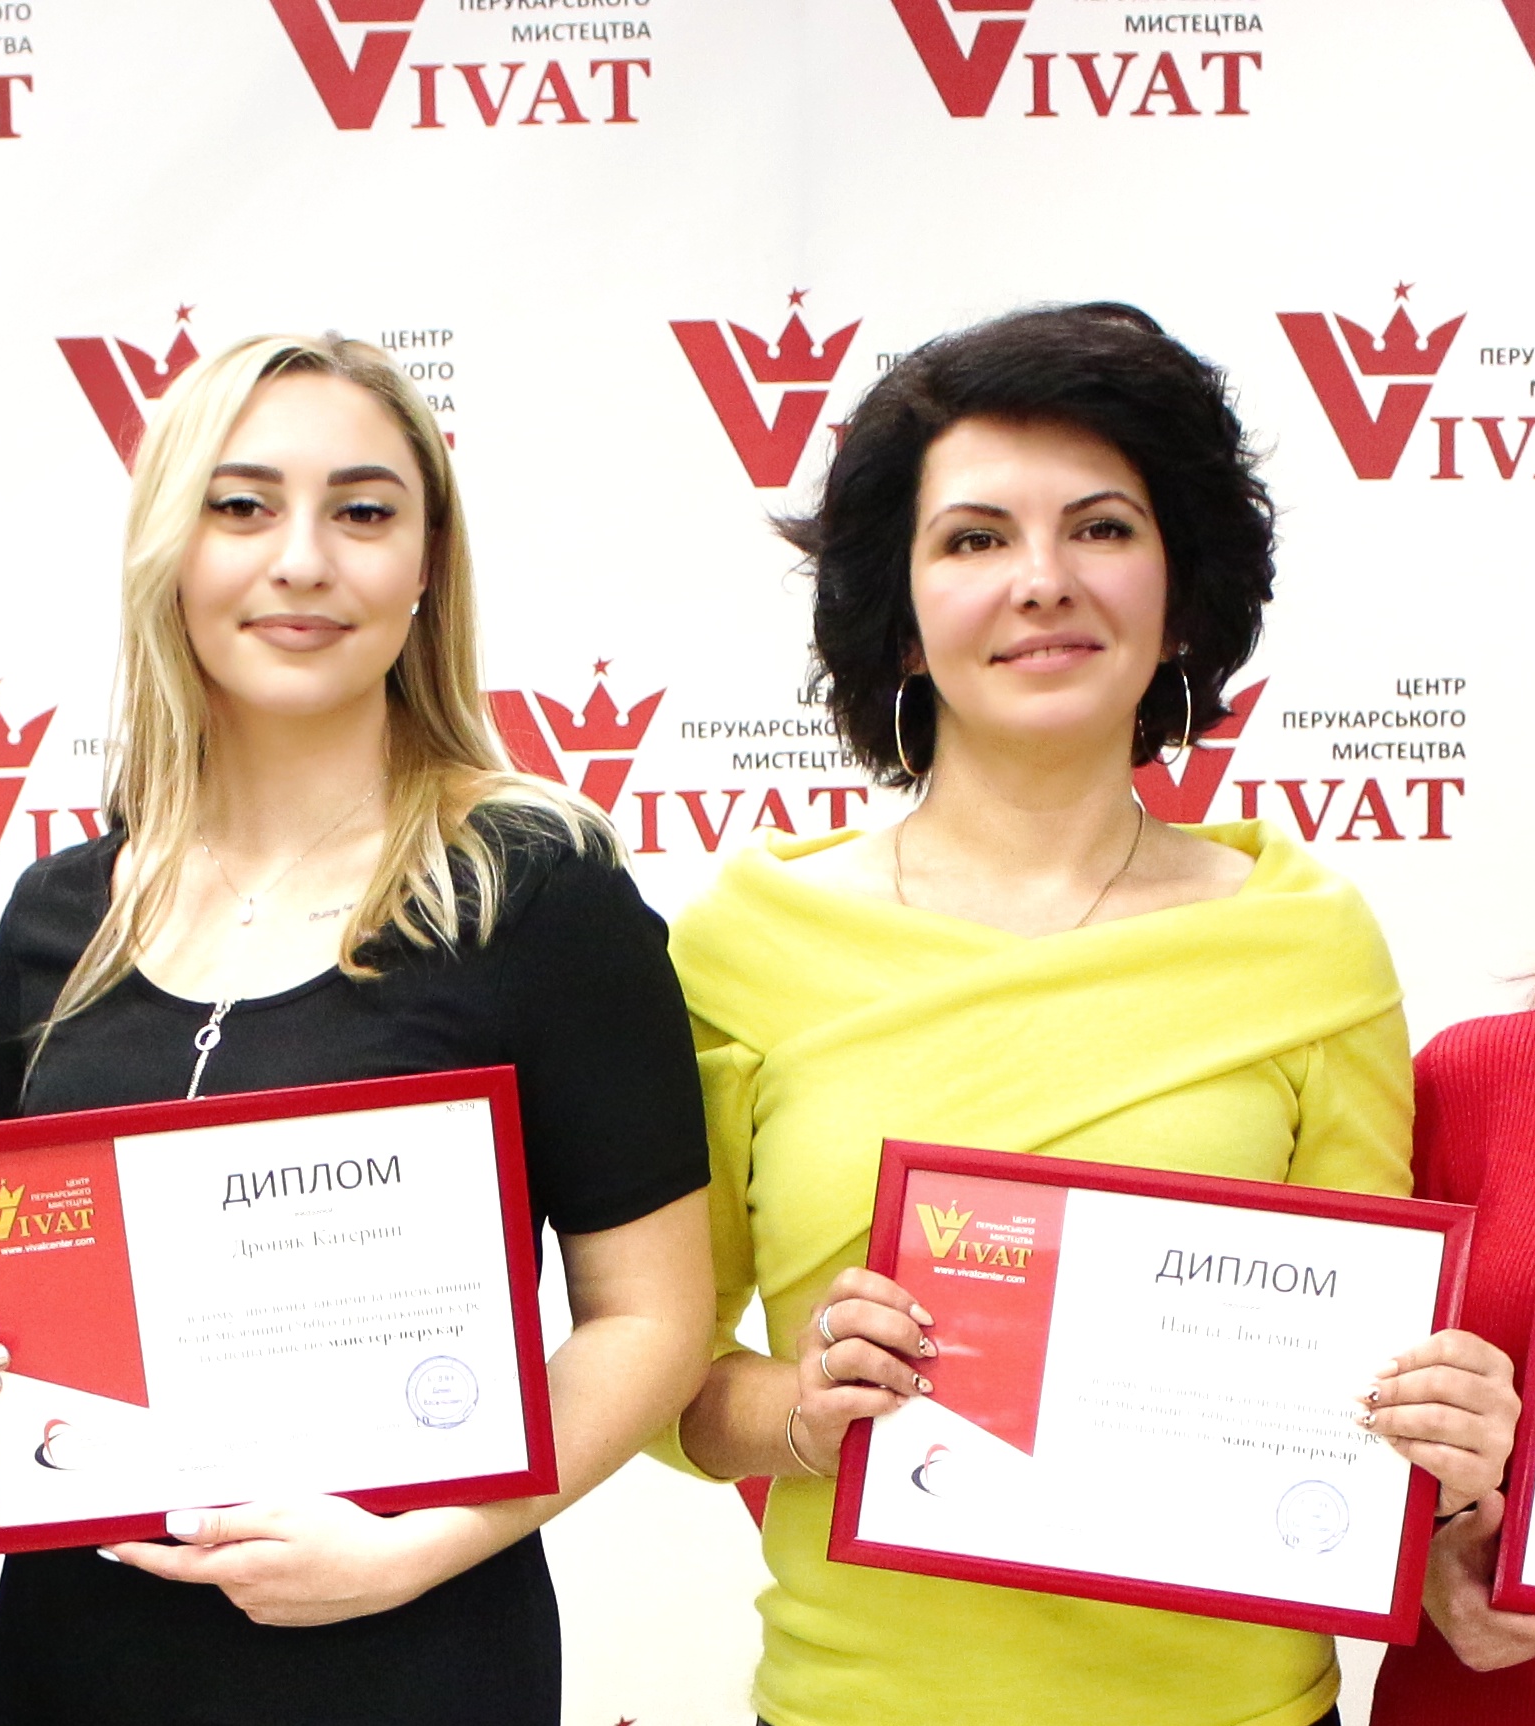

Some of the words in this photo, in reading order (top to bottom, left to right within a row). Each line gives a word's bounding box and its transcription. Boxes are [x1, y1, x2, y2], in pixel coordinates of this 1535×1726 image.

[511, 21, 652, 44] МИСТЕЦТВА
[1125, 13, 1263, 37] МИСТЕЦТВА
[275, 0, 652, 130] VIVAT
[898, 0, 1263, 118] VIVAT
[379, 329, 454, 355] ЦЕНТР
[1396, 677, 1466, 700] ЦЕНТР
[681, 720, 835, 741] ПЕРУКАРСЬКО
[1282, 709, 1466, 729] ПЕРУКАРСЬКОГО
[1332, 741, 1466, 763] МИСТЕЦТВА
[222, 1154, 402, 1211] ДИПЛОМ
[915, 1203, 1033, 1269] VIVAT
[1155, 1249, 1338, 1298] ДИПЛОМ
